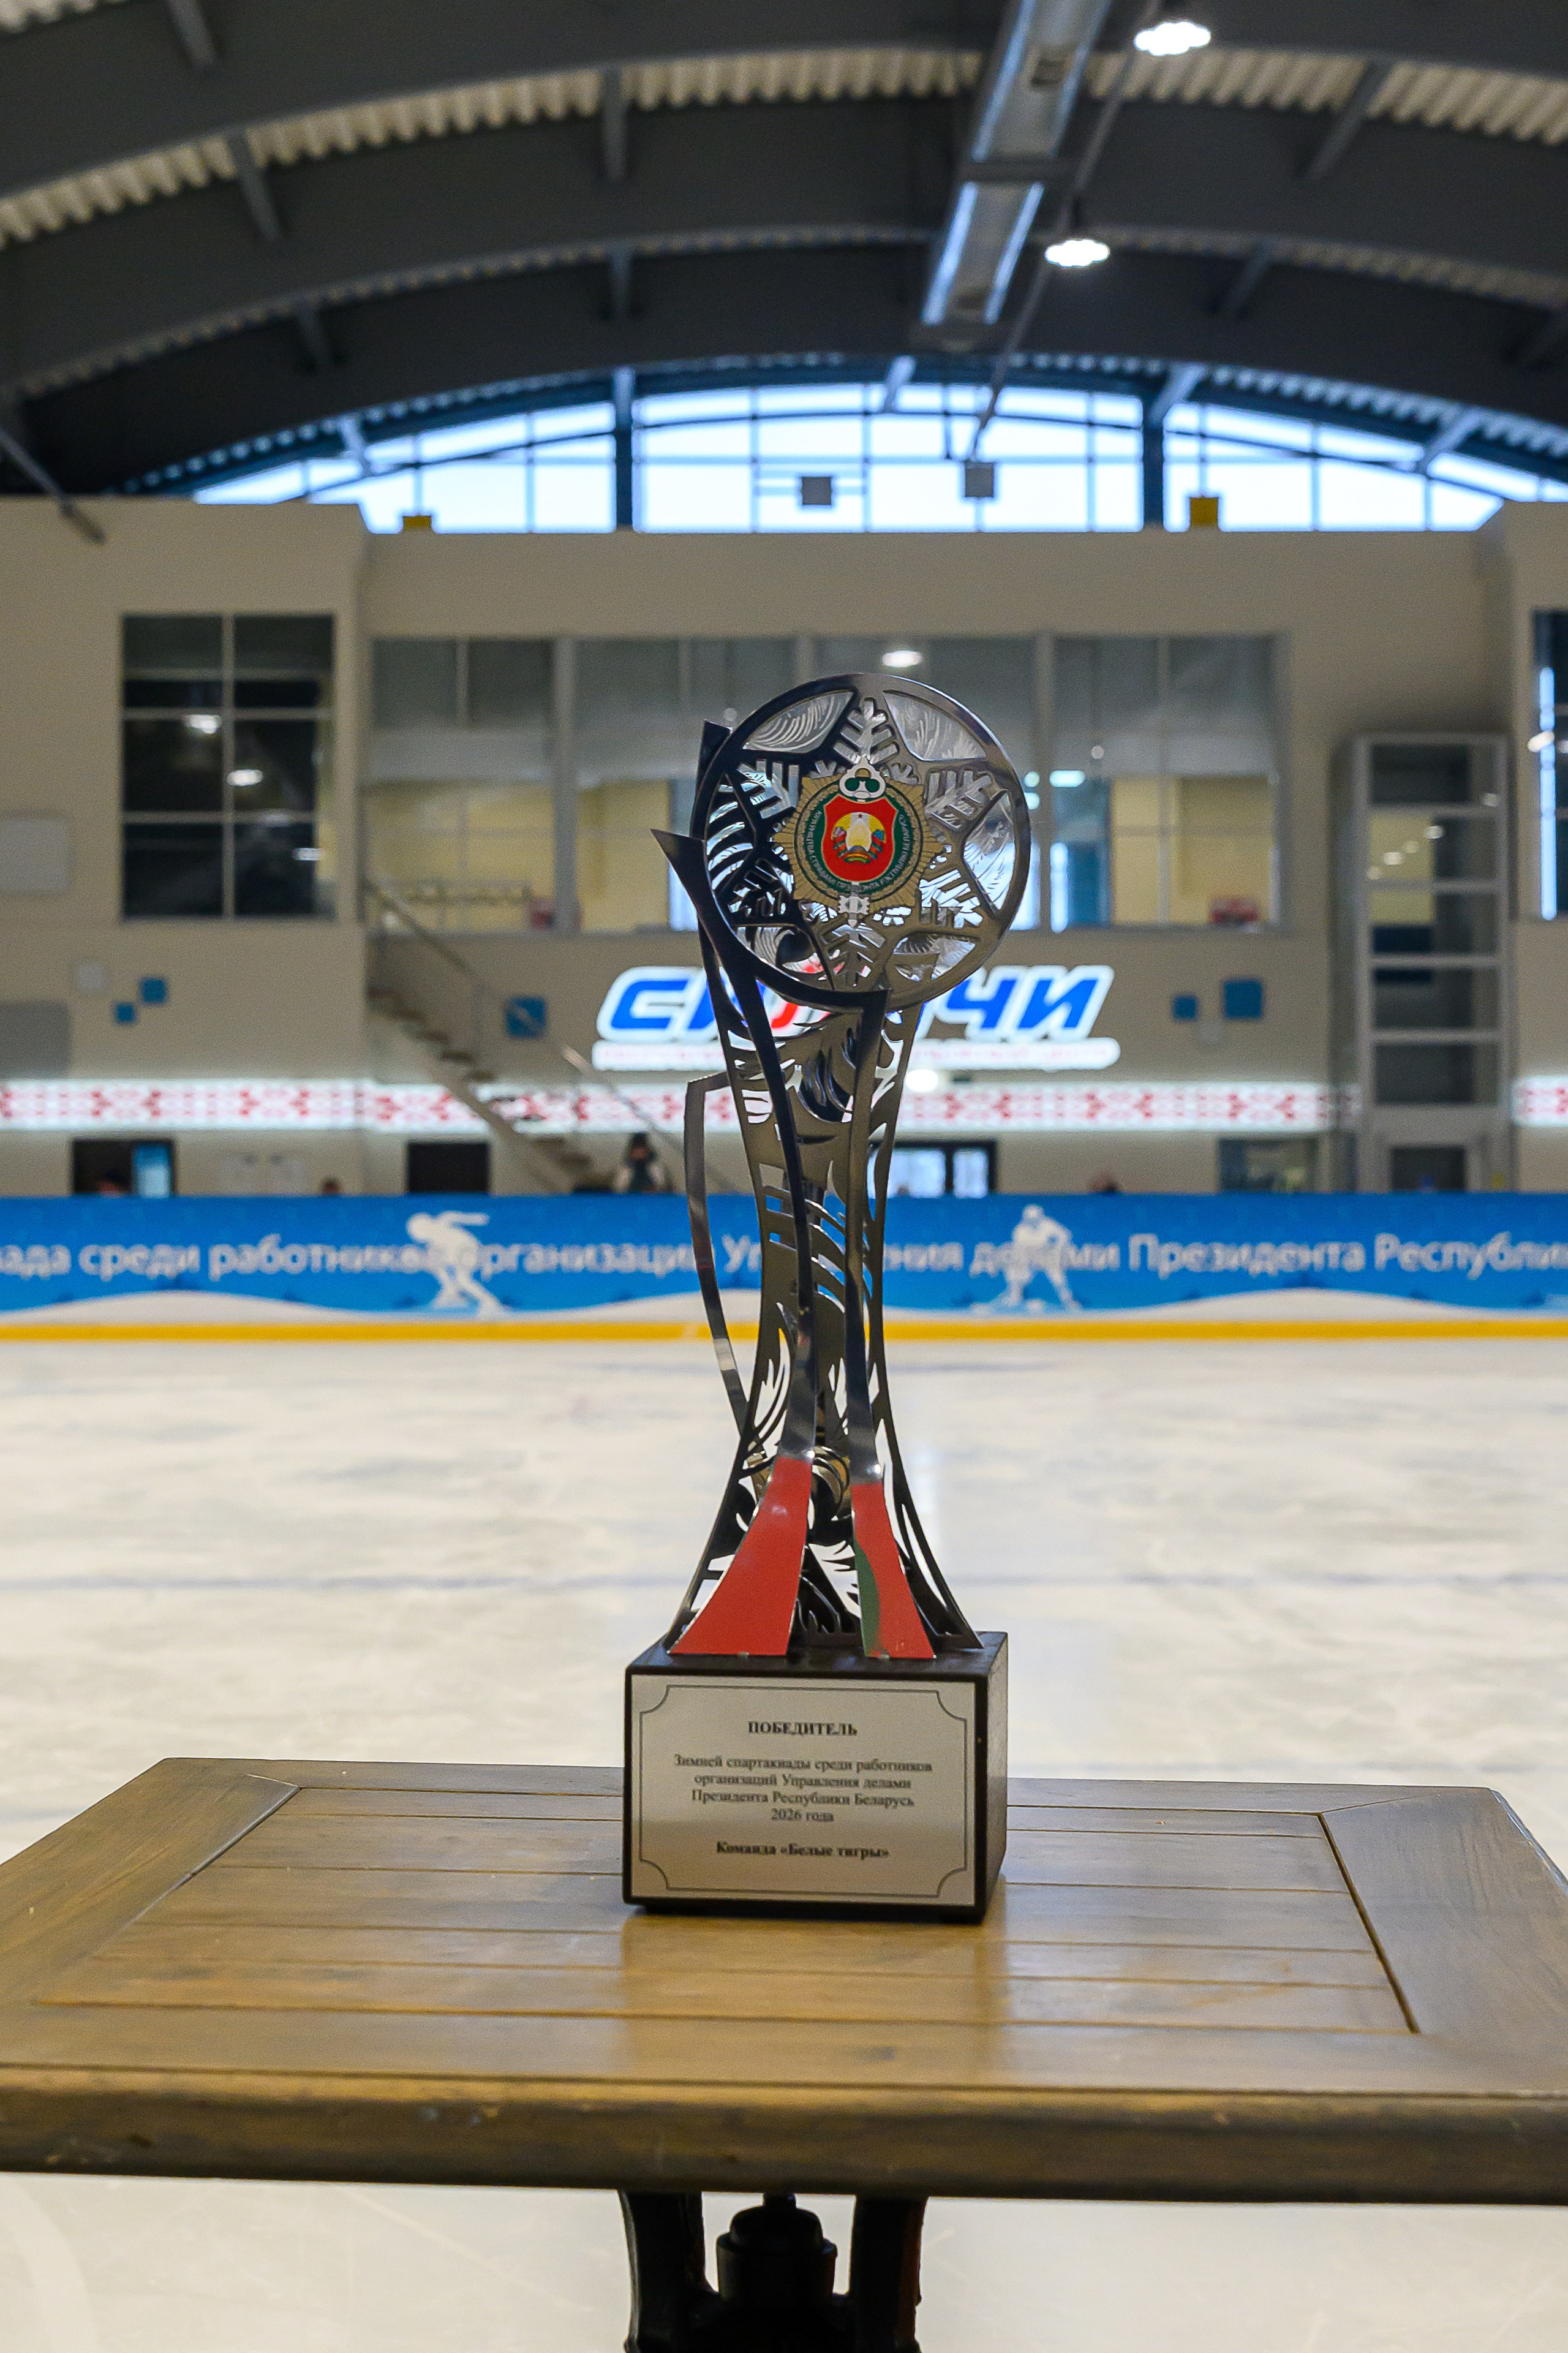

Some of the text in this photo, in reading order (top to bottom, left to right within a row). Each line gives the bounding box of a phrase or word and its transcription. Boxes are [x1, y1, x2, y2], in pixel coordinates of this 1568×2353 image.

[78, 1242, 201, 1282] среди
[1129, 1233, 1366, 1280] Президента
[1374, 1231, 1568, 1280] Республи
[748, 1720, 858, 1735] ПОБЕДИТЕЛЬ
[674, 1753, 932, 1773] Зимней спартакиады среди работников
[694, 1773, 911, 1789] организаций Управления делами
[692, 1789, 914, 1808] Президента Республики Беларусь
[771, 1808, 834, 1822] 2026 года
[717, 1840, 889, 1860] Команда «Белые тигры»
